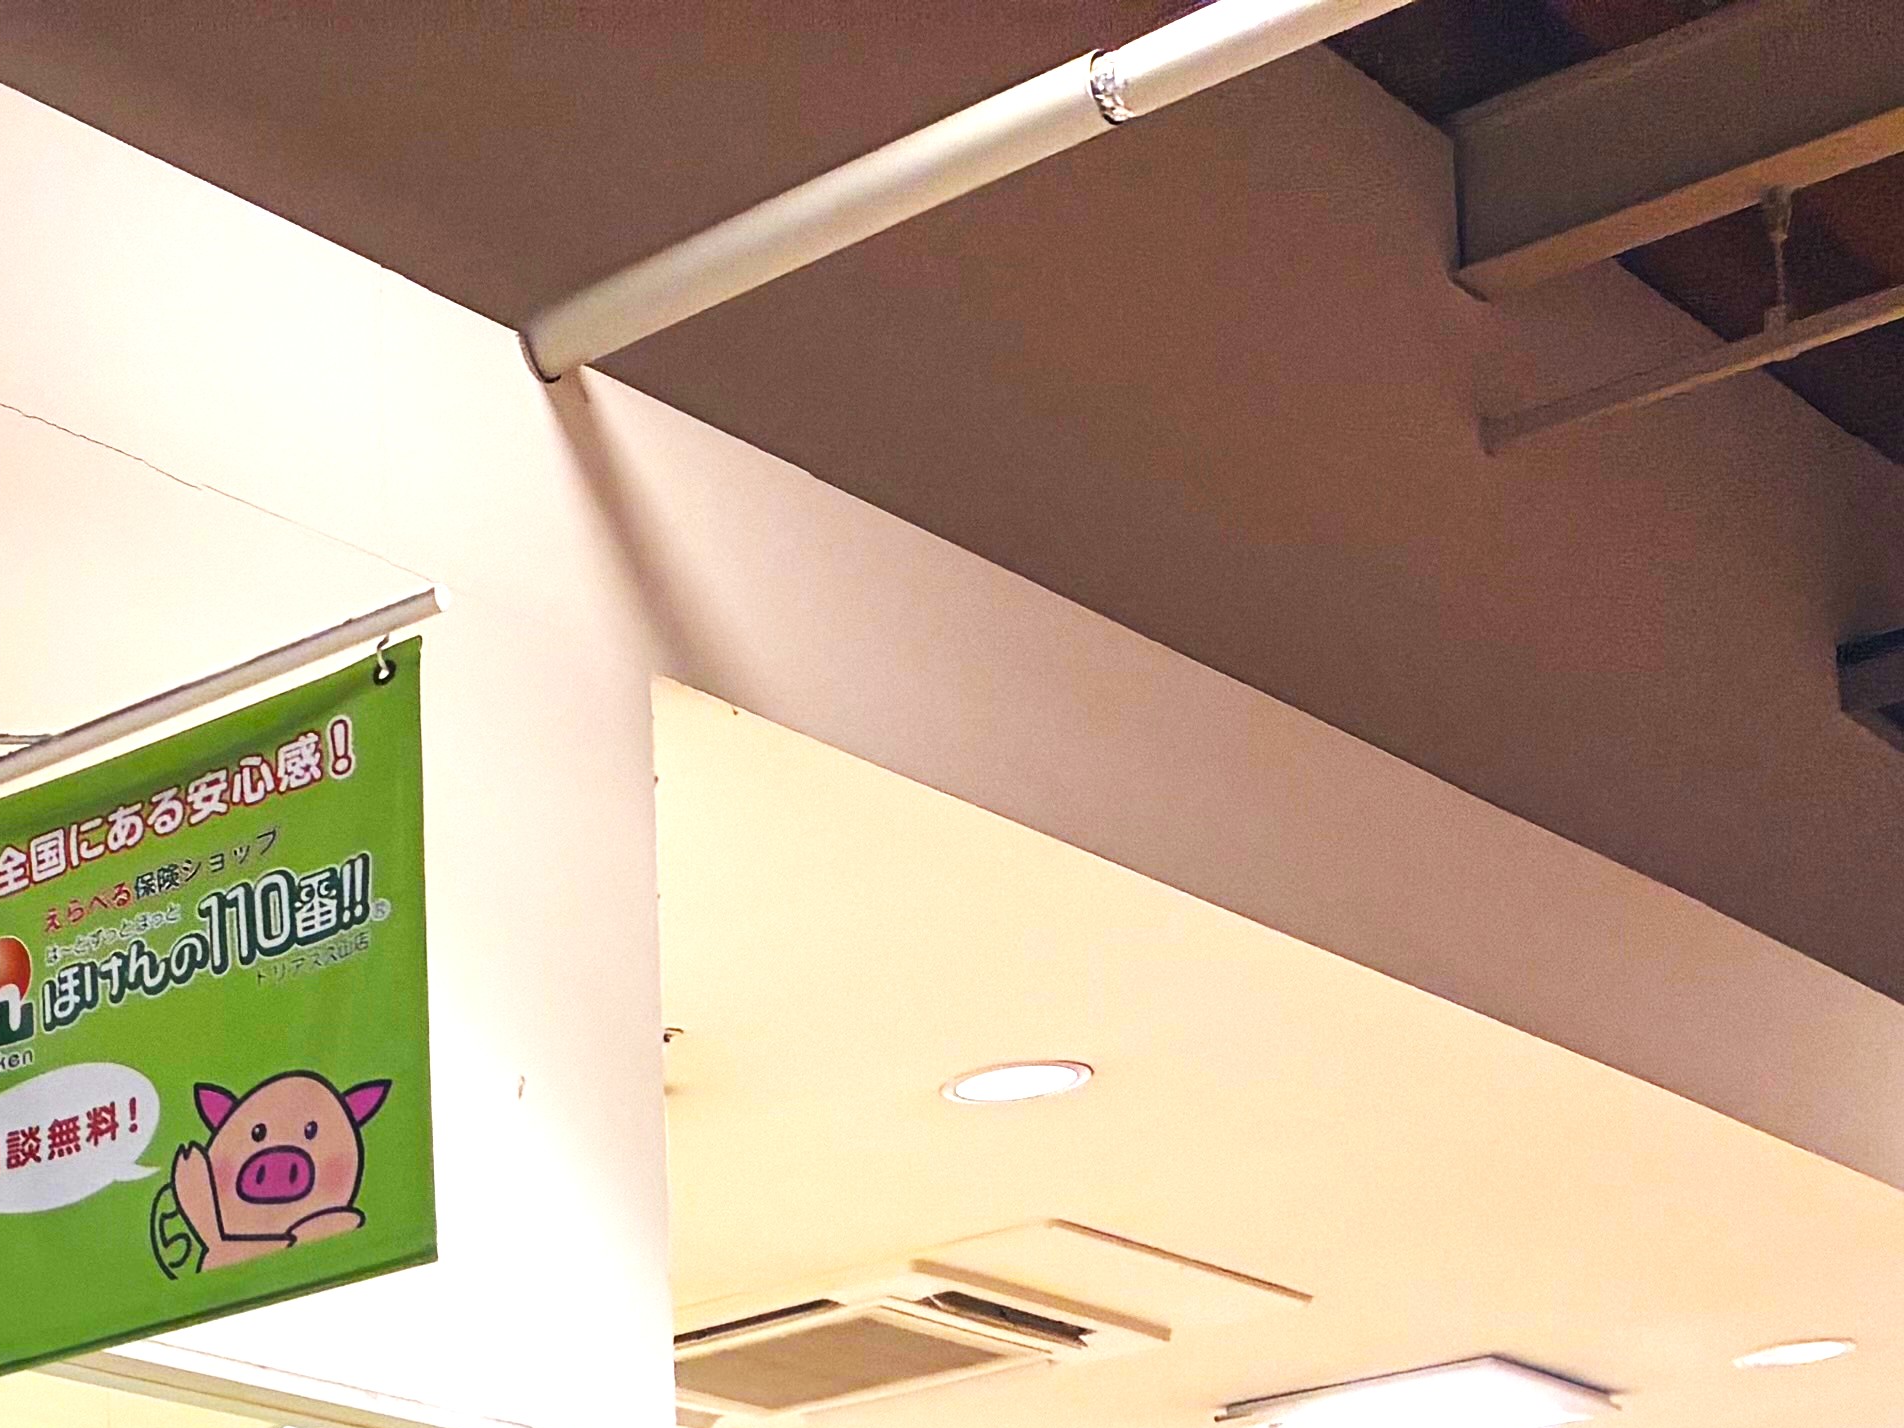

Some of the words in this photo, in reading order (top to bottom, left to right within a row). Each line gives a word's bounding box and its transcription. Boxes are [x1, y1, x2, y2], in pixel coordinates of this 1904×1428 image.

[43, 826, 280, 935] えらべる保険ショップ
